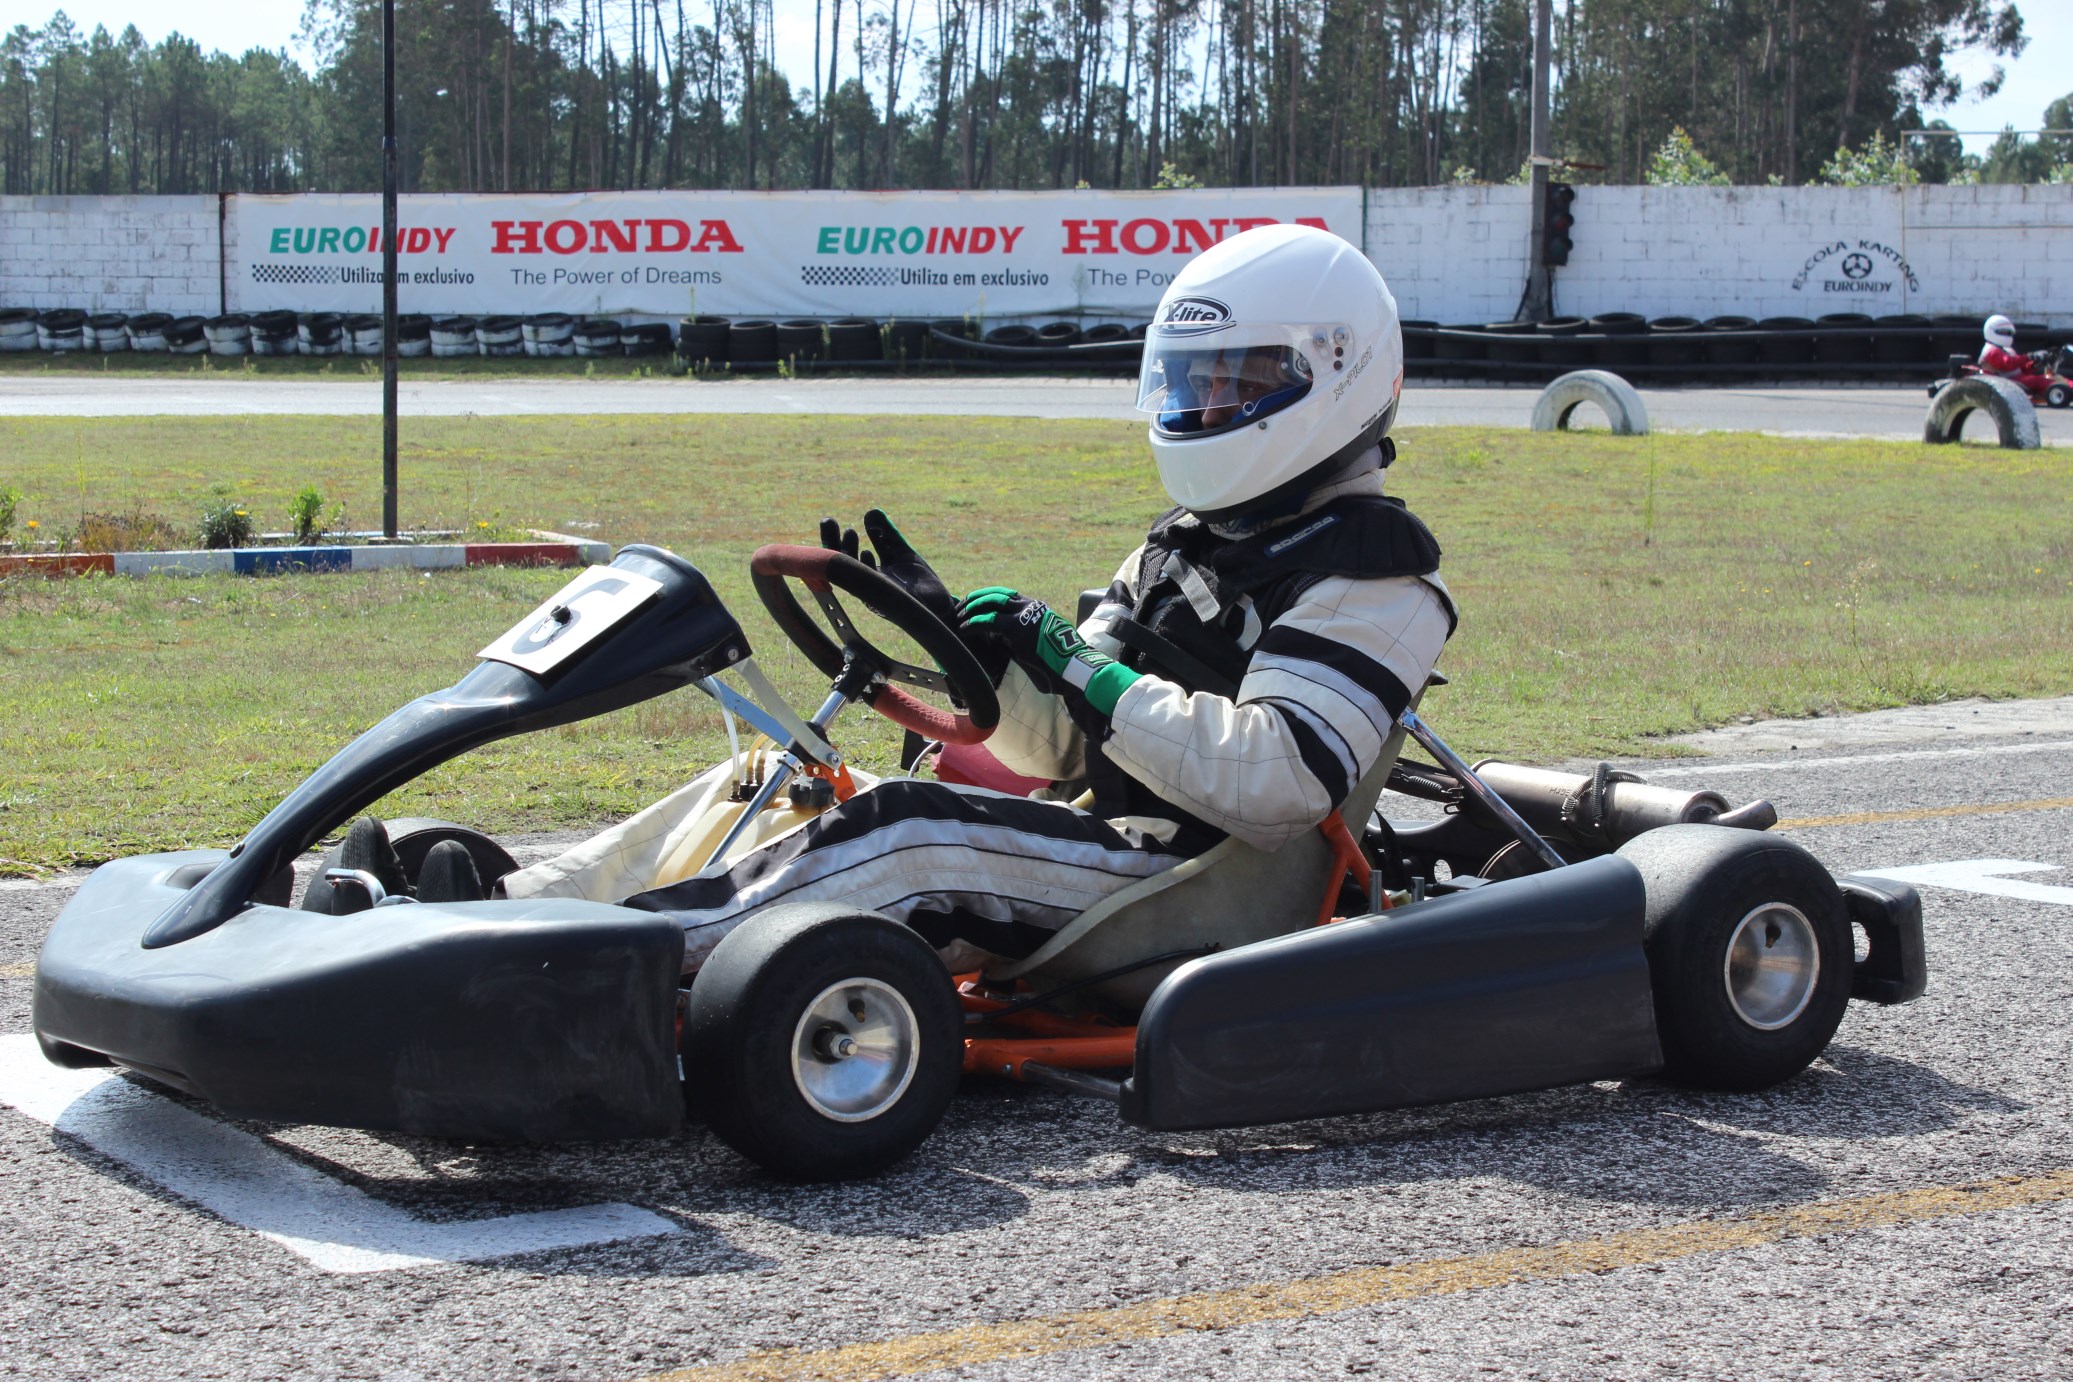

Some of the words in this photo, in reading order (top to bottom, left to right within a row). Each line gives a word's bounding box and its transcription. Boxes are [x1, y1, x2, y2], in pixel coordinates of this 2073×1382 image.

[491, 219, 744, 255] HONDA
[816, 226, 1025, 255] EUROINDY
[1062, 217, 1332, 256] HON
[414, 266, 475, 284] exclusivo
[1792, 241, 1848, 291] ESCOLA
[1859, 240, 1920, 292] KARTING
[510, 268, 547, 285] The
[554, 268, 614, 285] Power
[621, 267, 640, 284] of
[646, 267, 722, 284] Dreams
[900, 267, 948, 286] Utiliza
[953, 273, 976, 286] em
[981, 267, 1049, 286] exclusivo
[1088, 268, 1127, 286] The
[1823, 280, 1893, 292] EUROINDY
